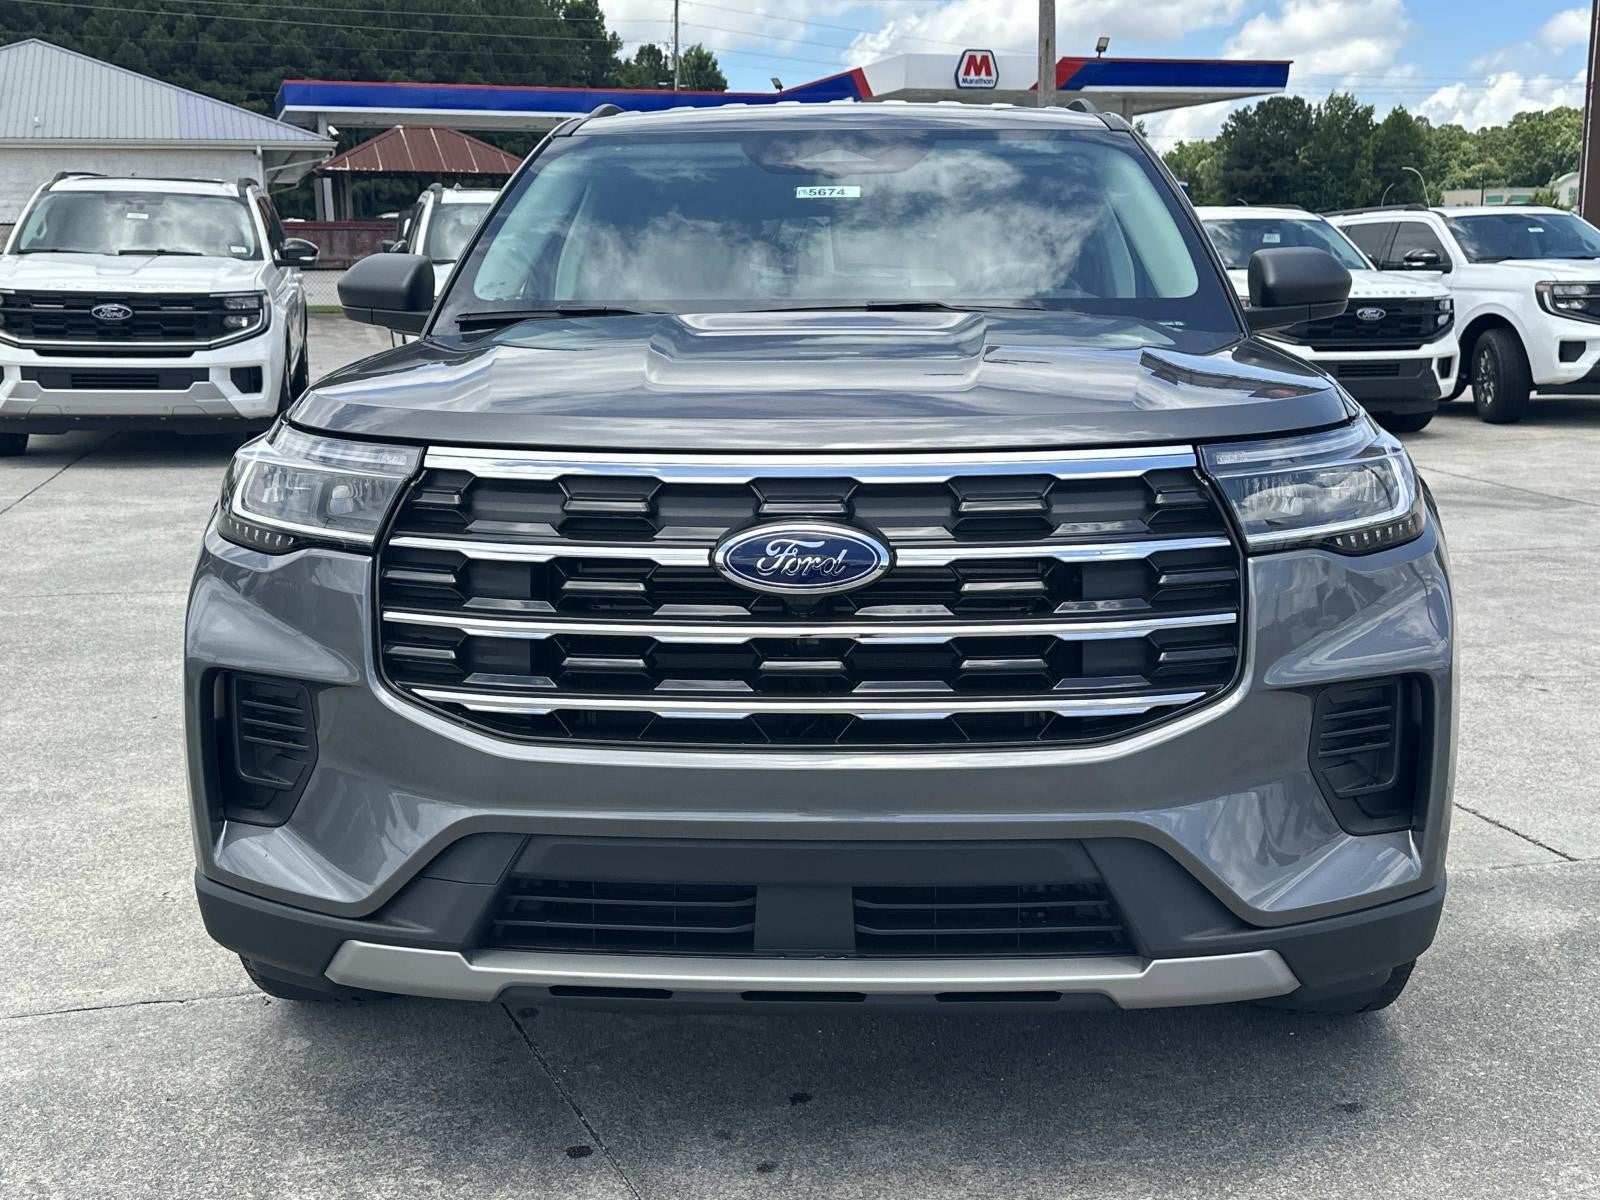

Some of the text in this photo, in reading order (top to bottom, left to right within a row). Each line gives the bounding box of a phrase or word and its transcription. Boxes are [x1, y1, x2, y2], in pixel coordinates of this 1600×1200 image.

[963, 54, 992, 77] M
[961, 77, 994, 85] Marathon
[808, 188, 846, 197] 5674
[99, 306, 125, 319] Ford
[756, 538, 848, 577] Ford
